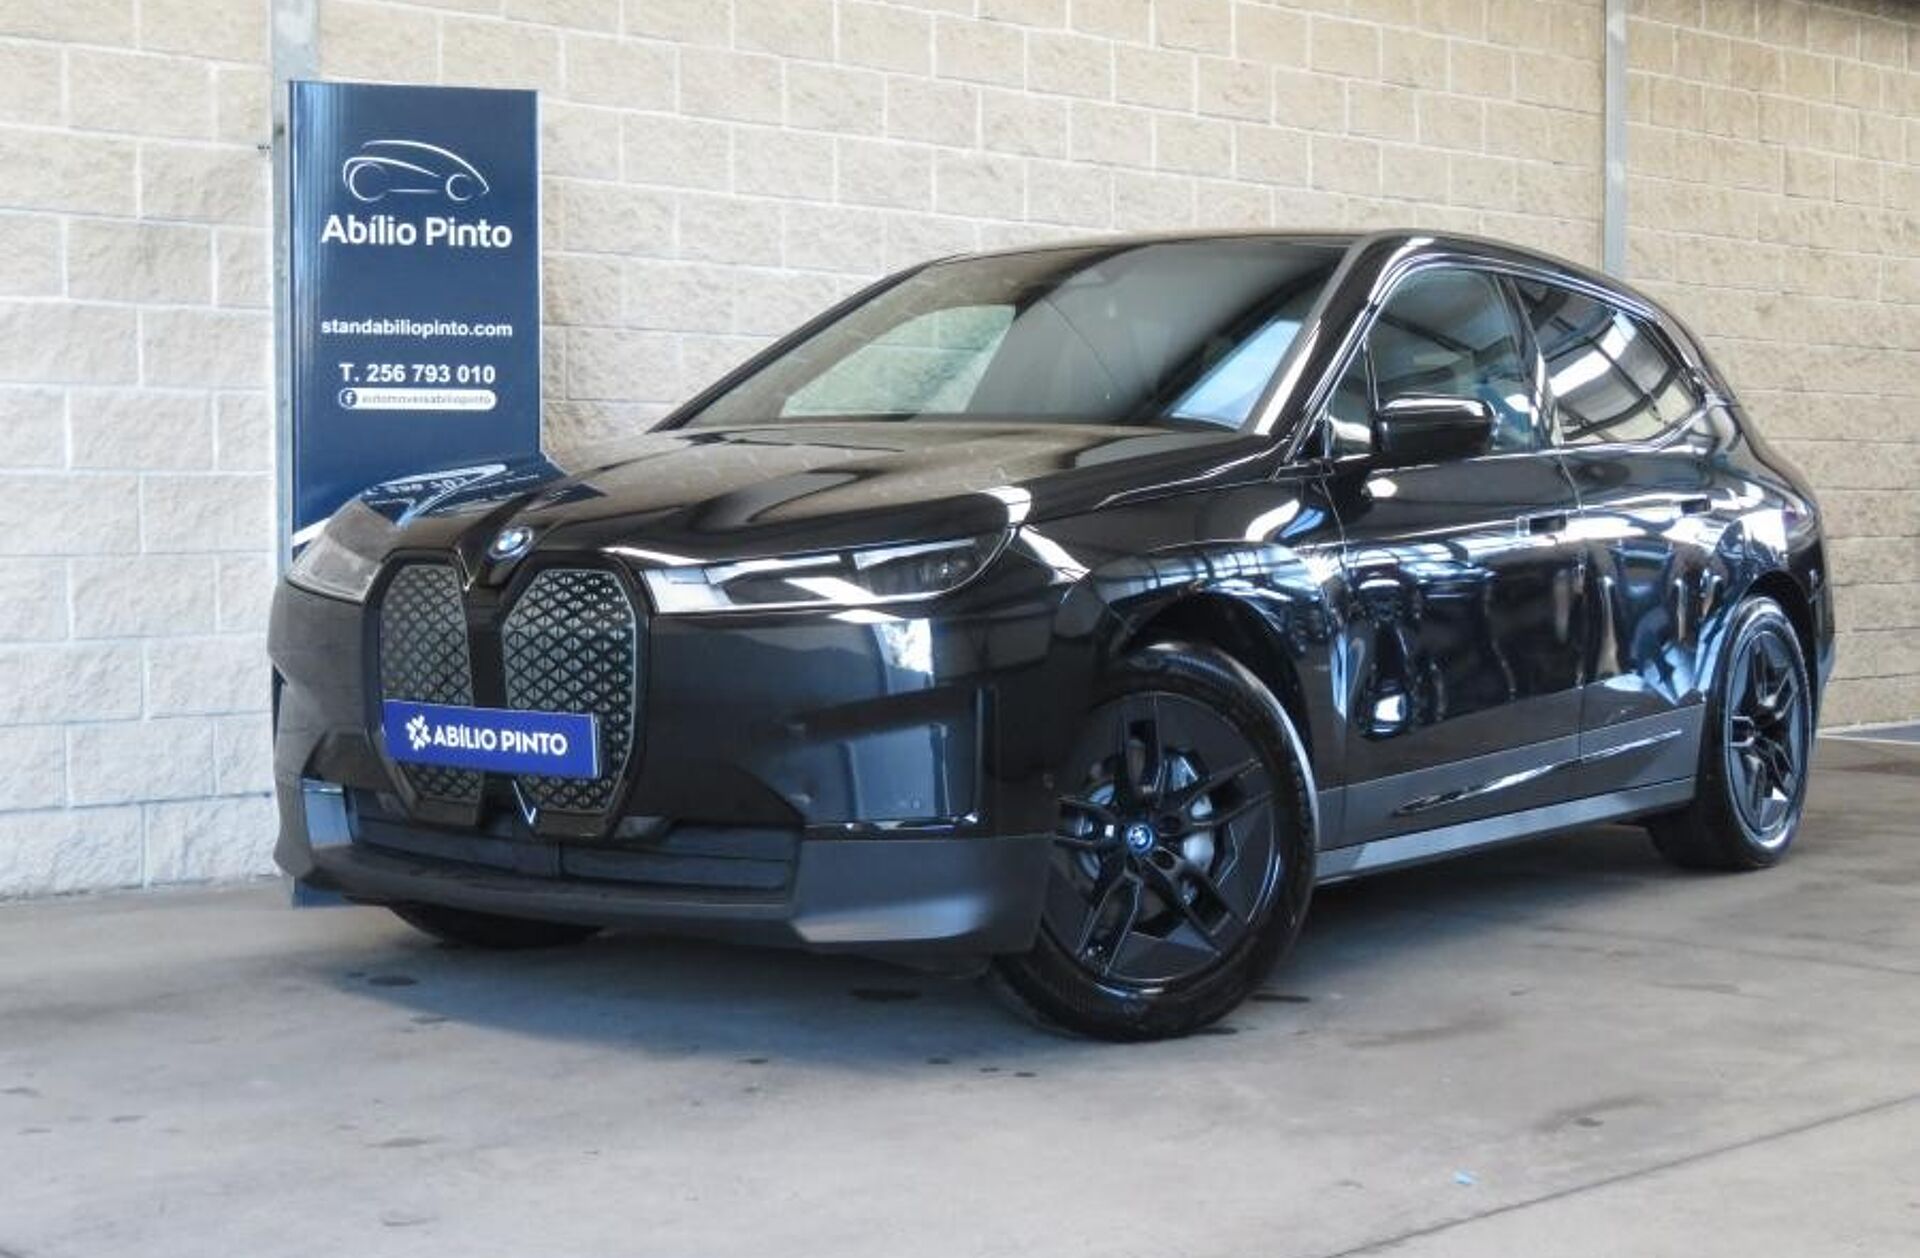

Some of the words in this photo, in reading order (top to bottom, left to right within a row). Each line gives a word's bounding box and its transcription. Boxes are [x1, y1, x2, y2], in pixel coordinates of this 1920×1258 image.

[321, 214, 417, 247] Abílio
[425, 217, 513, 248] Pinto
[321, 319, 513, 340] standabiliopinto.com
[339, 363, 360, 383] T.
[367, 364, 407, 384] 256
[412, 364, 451, 384] 793
[458, 365, 496, 385] 010
[433, 723, 497, 751] ABÍLIO
[500, 730, 569, 756] PINTO
